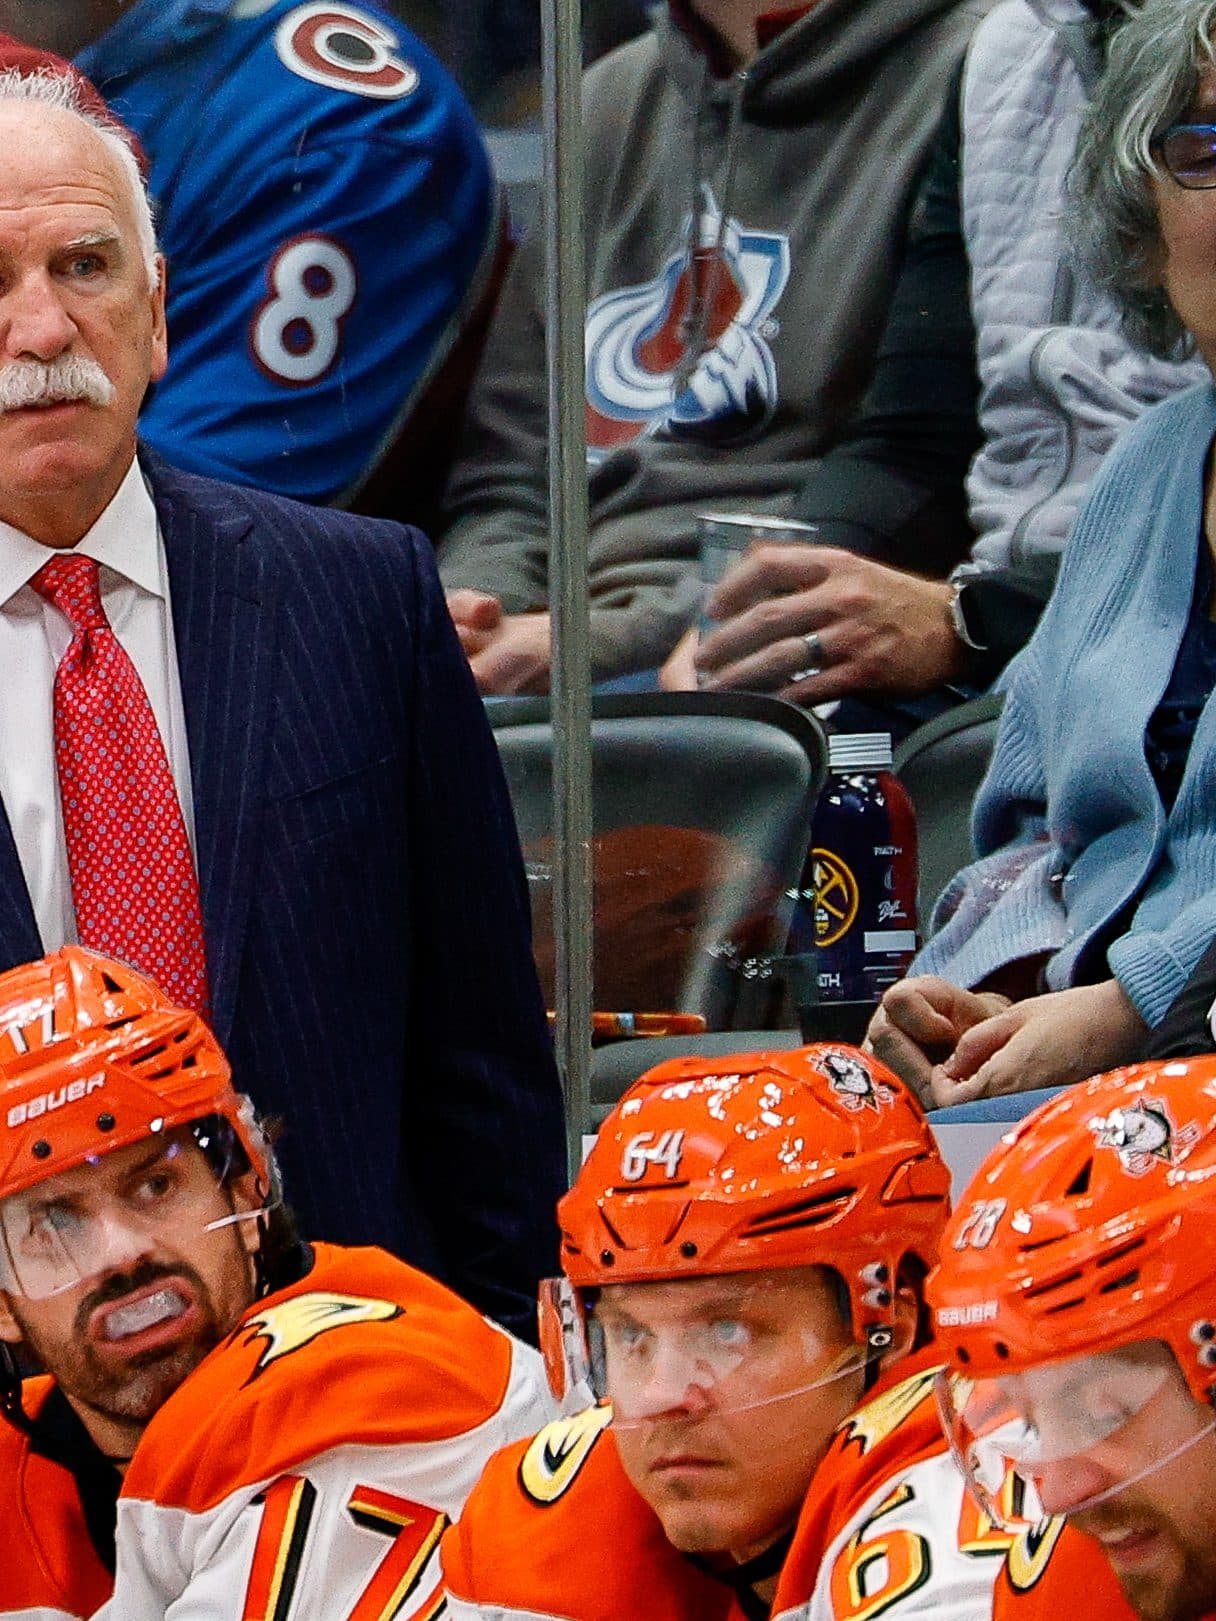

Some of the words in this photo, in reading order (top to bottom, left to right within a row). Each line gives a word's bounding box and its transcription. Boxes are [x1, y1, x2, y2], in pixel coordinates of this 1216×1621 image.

[248, 232, 357, 390] 8
[7, 1072, 106, 1128] BAUER
[621, 1129, 686, 1181] 64
[937, 1300, 999, 1327] BAUER
